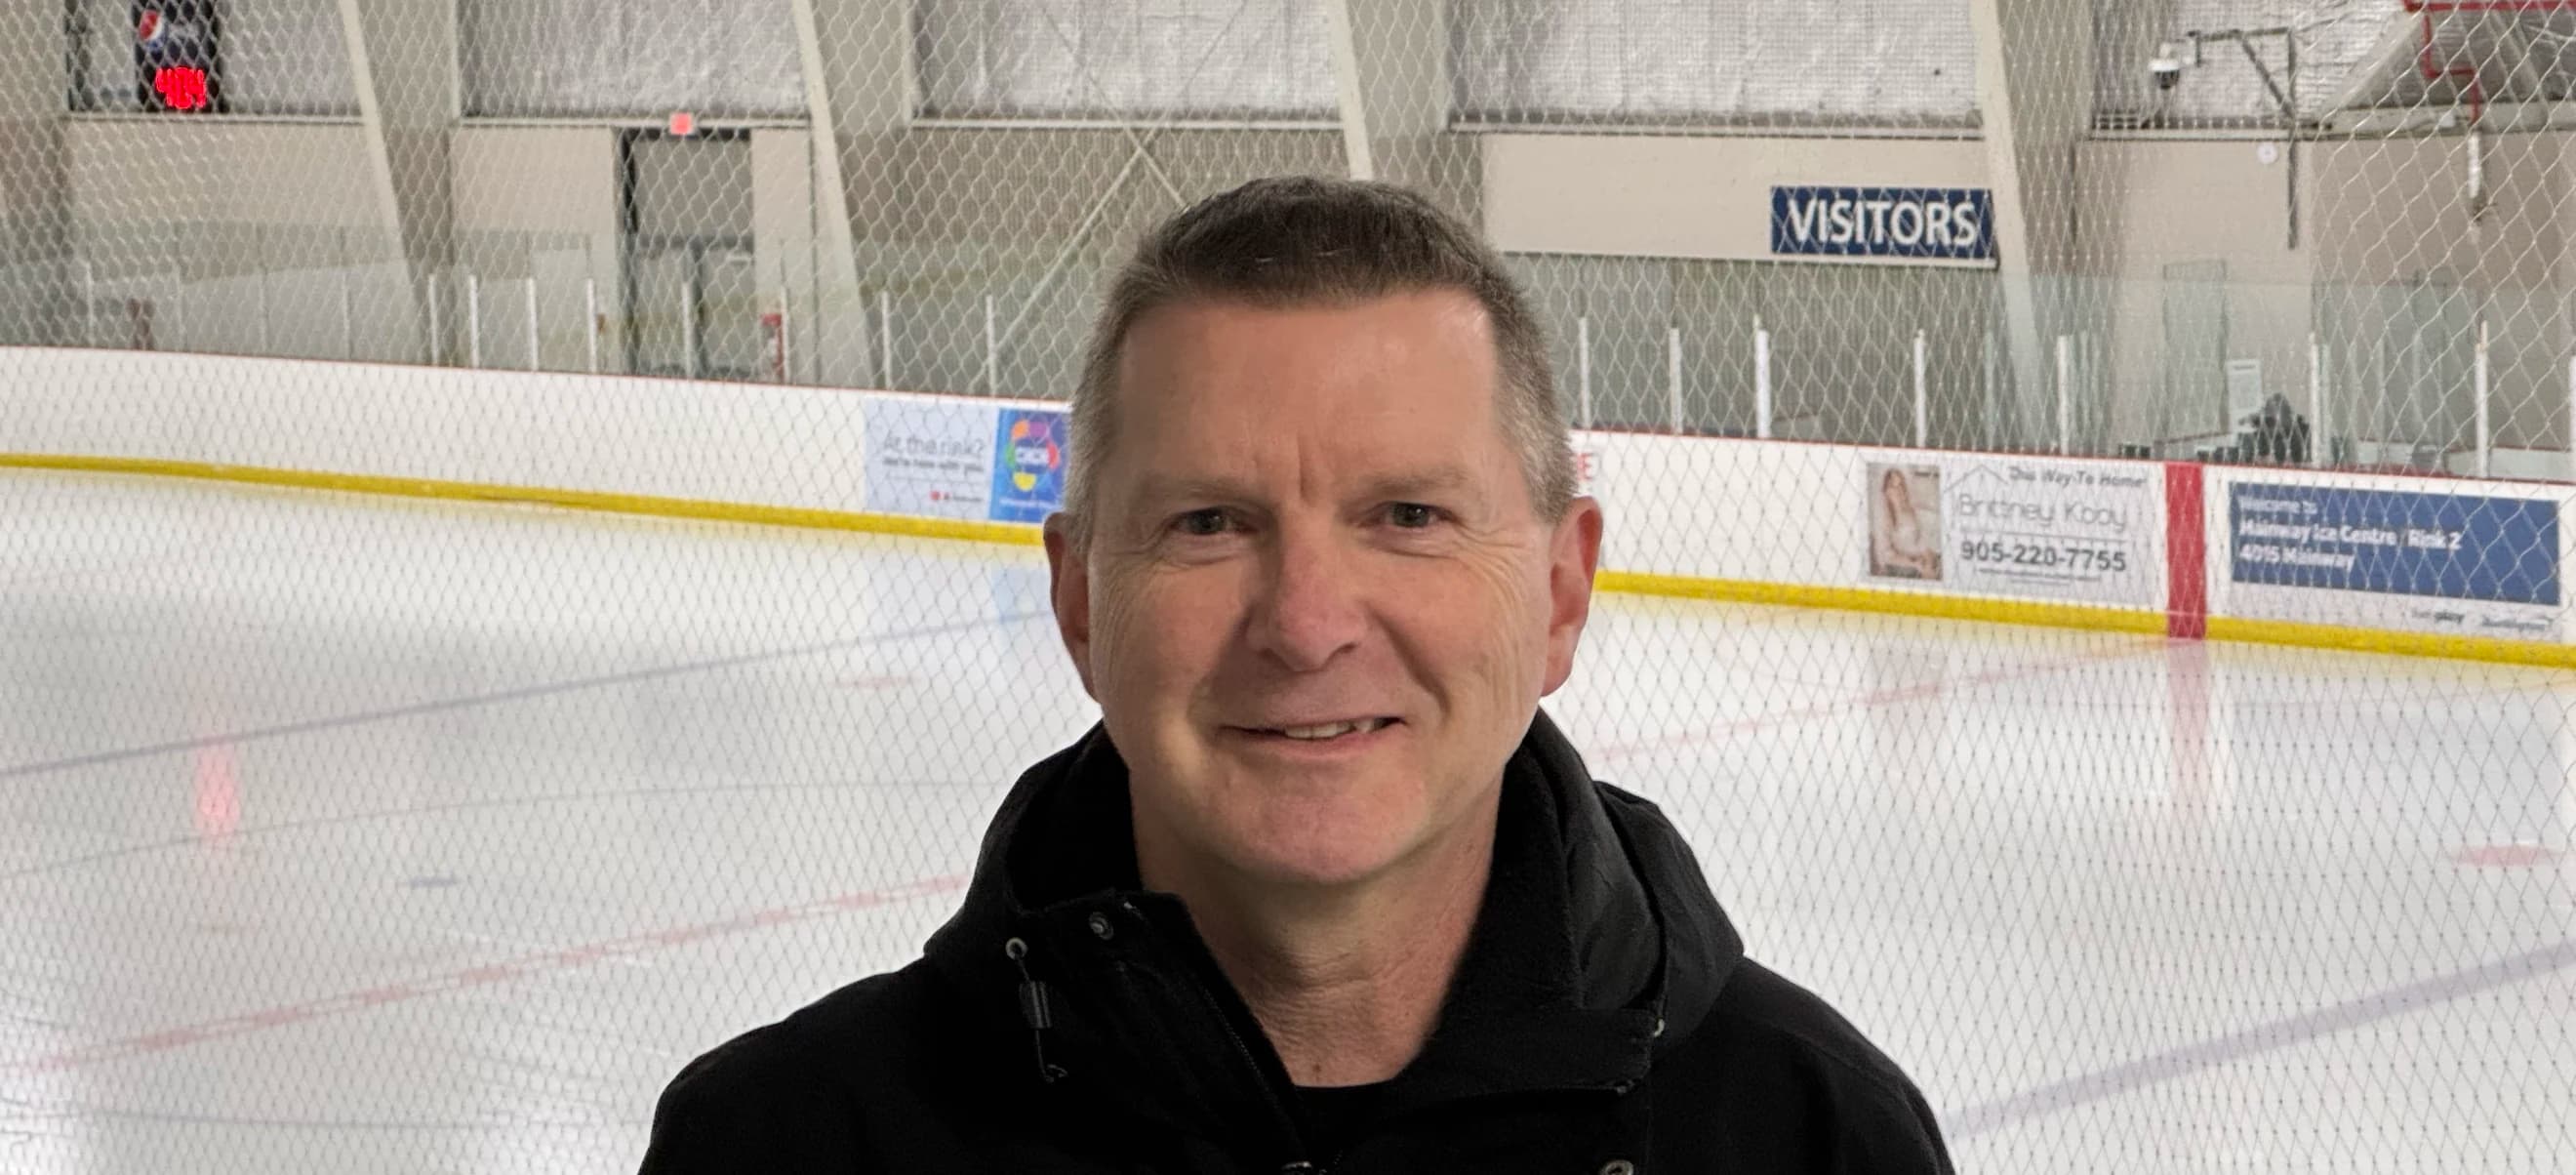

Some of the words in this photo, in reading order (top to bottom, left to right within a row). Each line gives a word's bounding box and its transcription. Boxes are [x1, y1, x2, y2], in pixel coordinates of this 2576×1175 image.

[1788, 198, 1976, 246] VISITORS
[2340, 524, 2396, 547] Centre
[2407, 528, 2446, 549] Rink
[2448, 531, 2462, 551] 2
[1960, 540, 2127, 572] 905-220-7755
